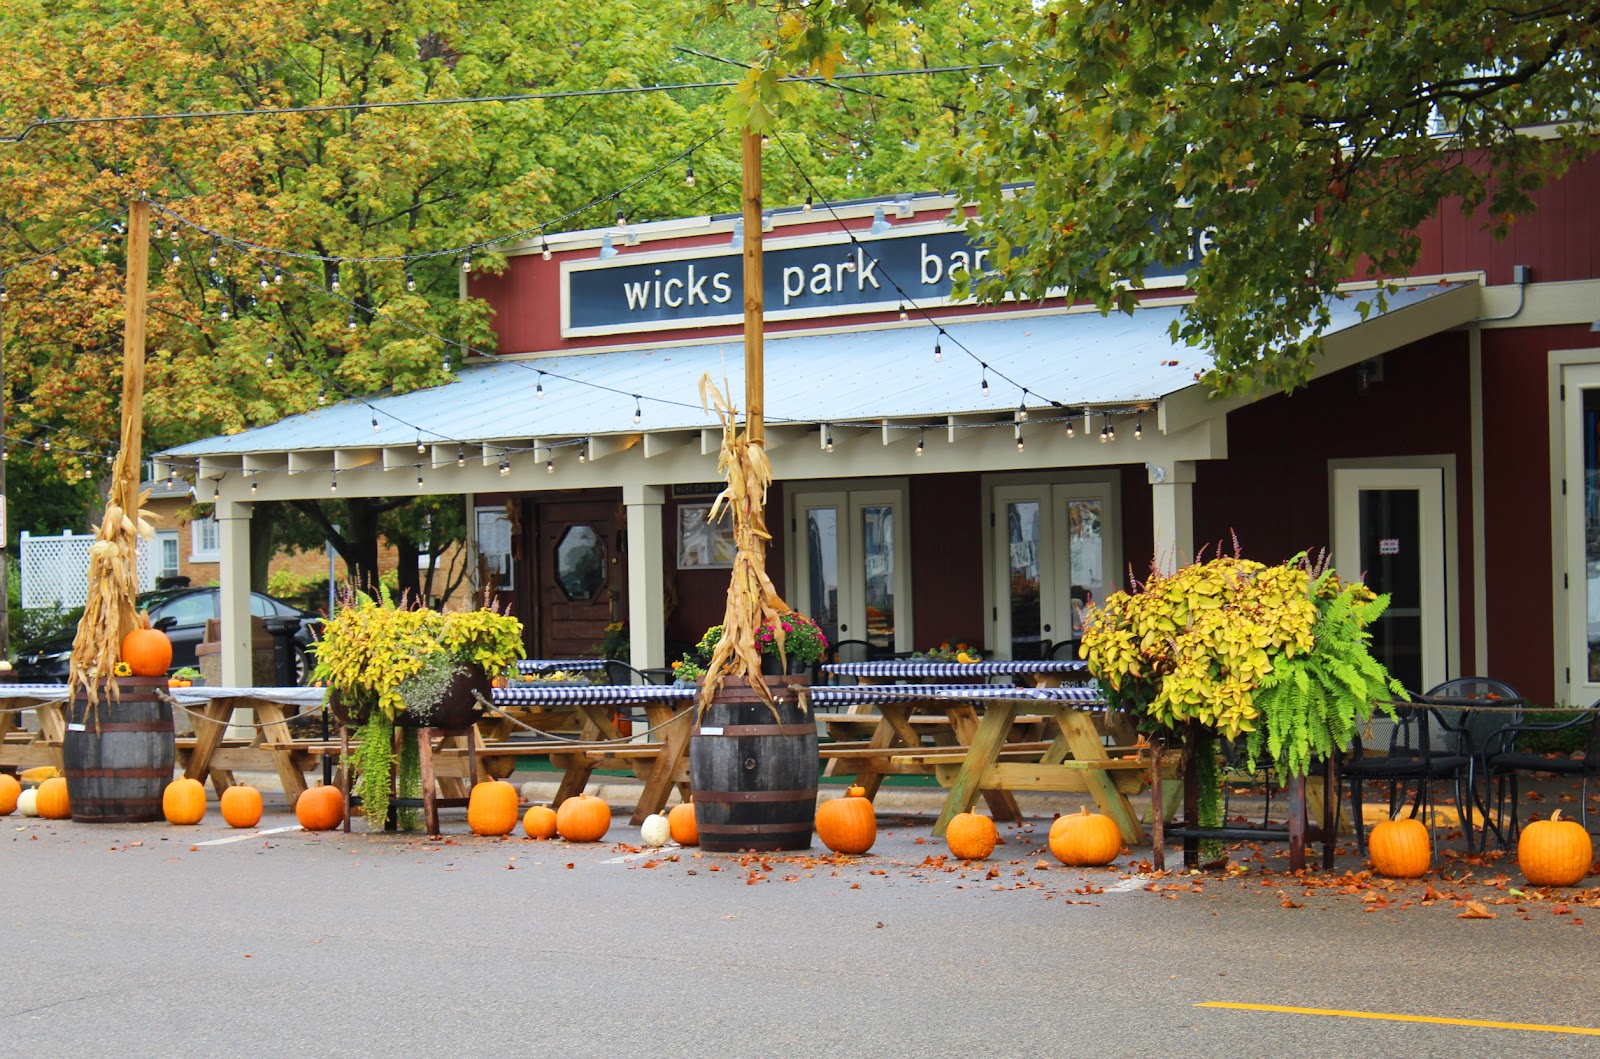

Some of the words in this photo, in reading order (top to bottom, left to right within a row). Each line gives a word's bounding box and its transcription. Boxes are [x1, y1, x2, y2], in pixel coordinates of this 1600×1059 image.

[624, 264, 732, 310] wicks
[783, 247, 880, 306] park
[921, 242, 991, 284] bar
